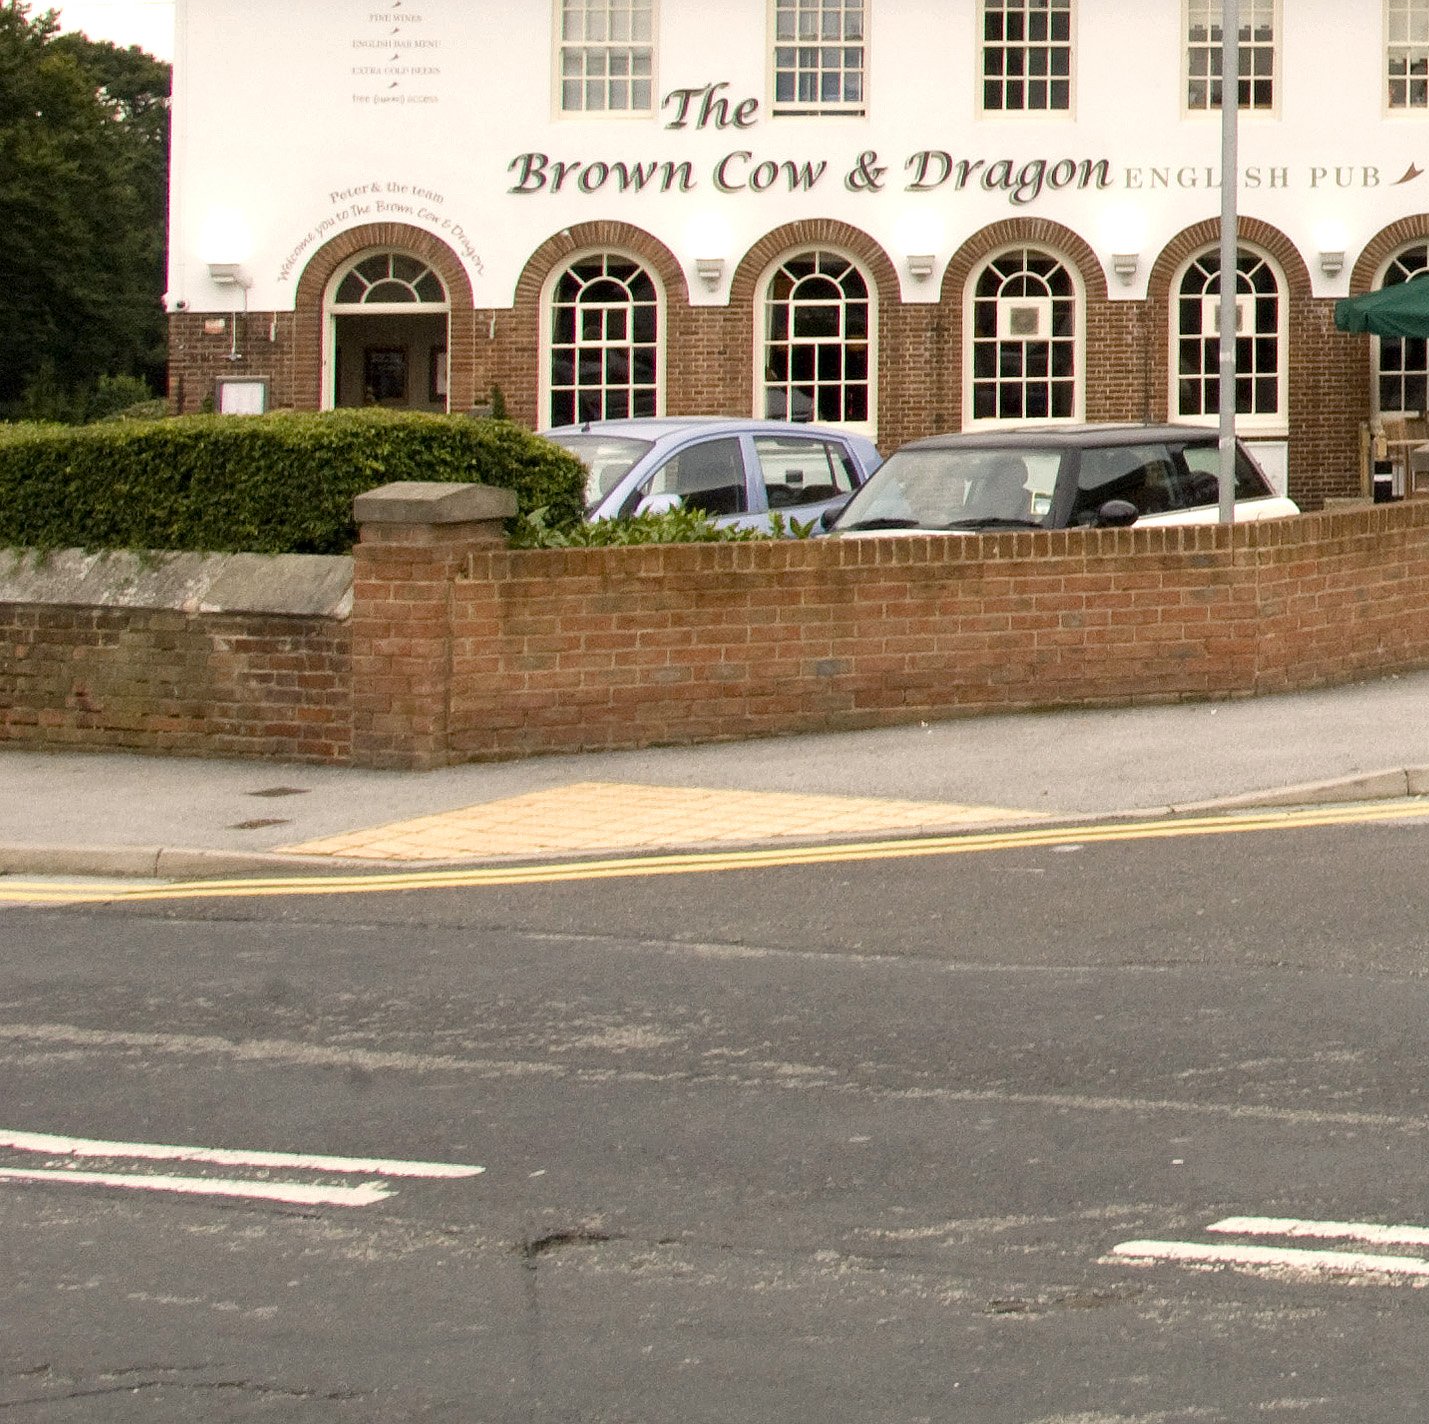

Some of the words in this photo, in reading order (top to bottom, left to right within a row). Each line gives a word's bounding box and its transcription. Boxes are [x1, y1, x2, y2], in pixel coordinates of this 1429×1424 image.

[661, 82, 759, 130] The
[329, 184, 369, 204] Peter
[370, 182, 381, 193] &
[386, 181, 408, 193] the
[412, 184, 445, 205] team
[506, 152, 697, 194] Brown
[712, 150, 827, 194] Cow
[844, 150, 889, 192] &
[904, 150, 1113, 206] Dragon
[1124, 166, 1289, 189] ENGLSH
[1309, 165, 1381, 189] PUB
[277, 231, 316, 283] Welcome
[315, 217, 335, 238] you
[336, 209, 349, 222] to
[350, 204, 371, 217] The
[376, 200, 413, 214] Brown
[417, 207, 440, 223] Cow
[451, 224, 485, 276] Dragon
